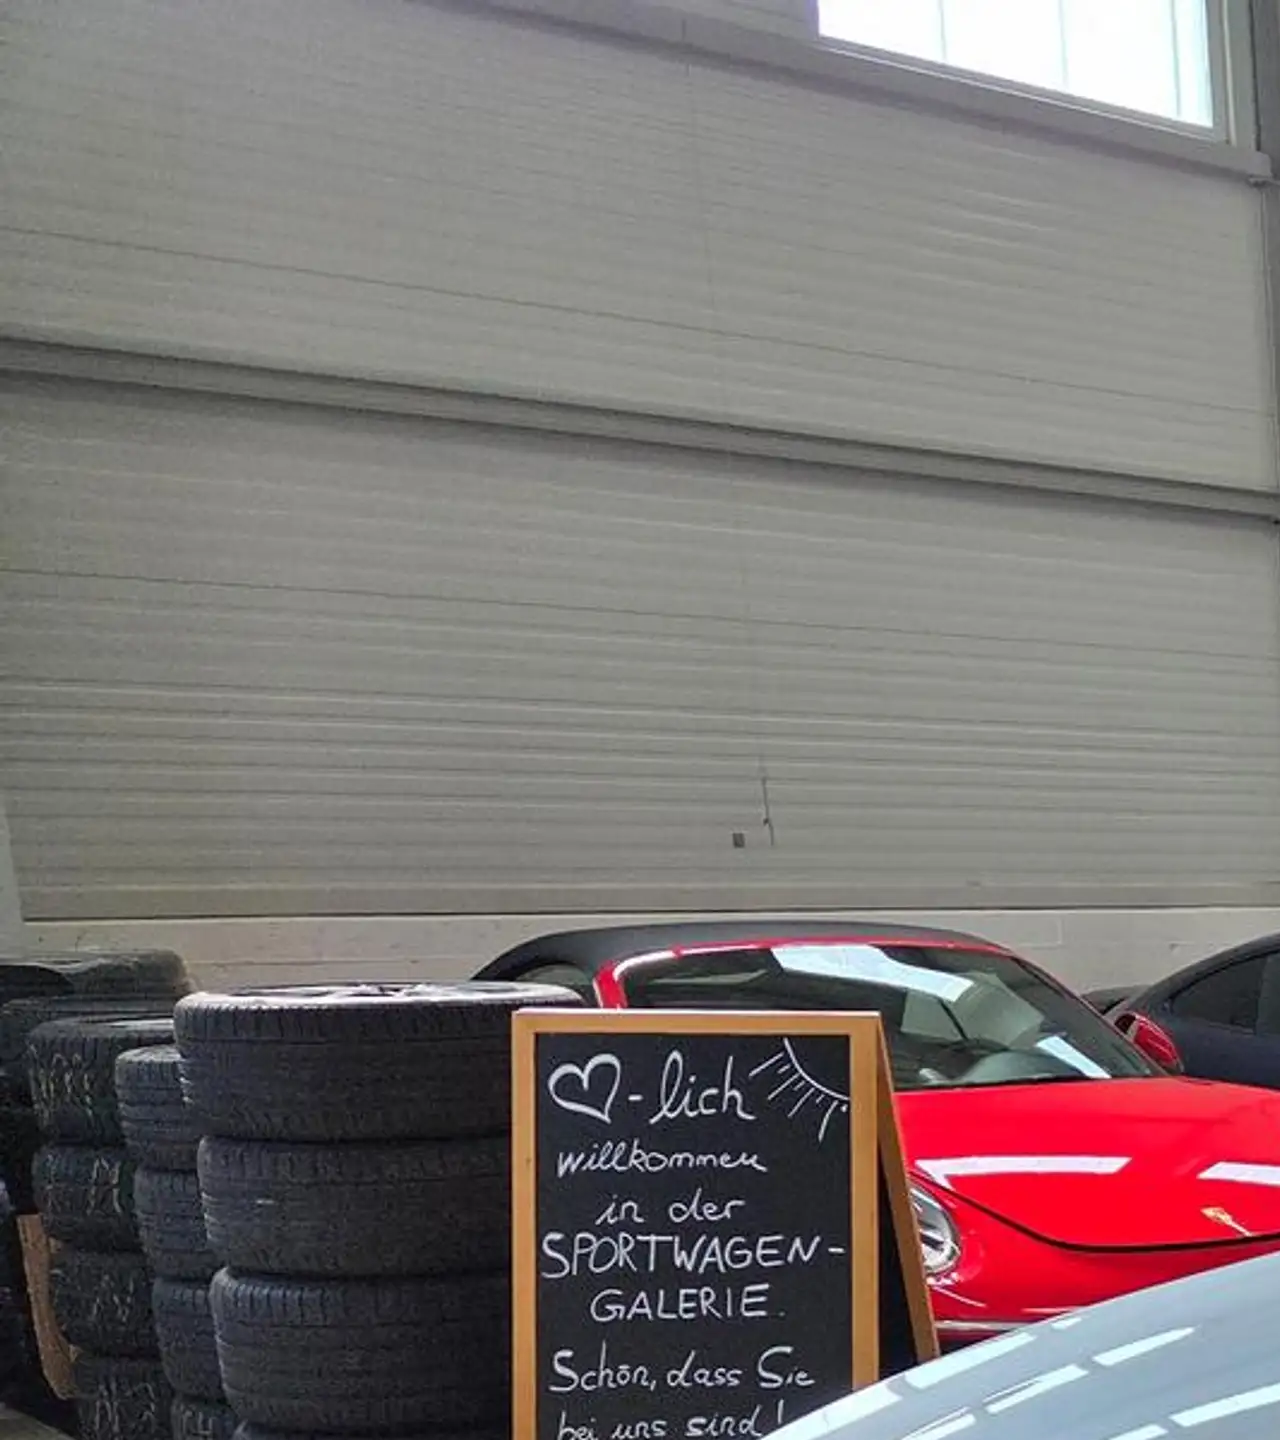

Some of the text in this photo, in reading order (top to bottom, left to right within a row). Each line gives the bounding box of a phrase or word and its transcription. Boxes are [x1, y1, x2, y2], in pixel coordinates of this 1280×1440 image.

[556, 1138, 769, 1178] willkommen
[595, 1187, 746, 1225] in der
[666, 1350, 743, 1387] dass
[757, 1346, 816, 1389] Sie
[610, 1419, 668, 1440] uns
